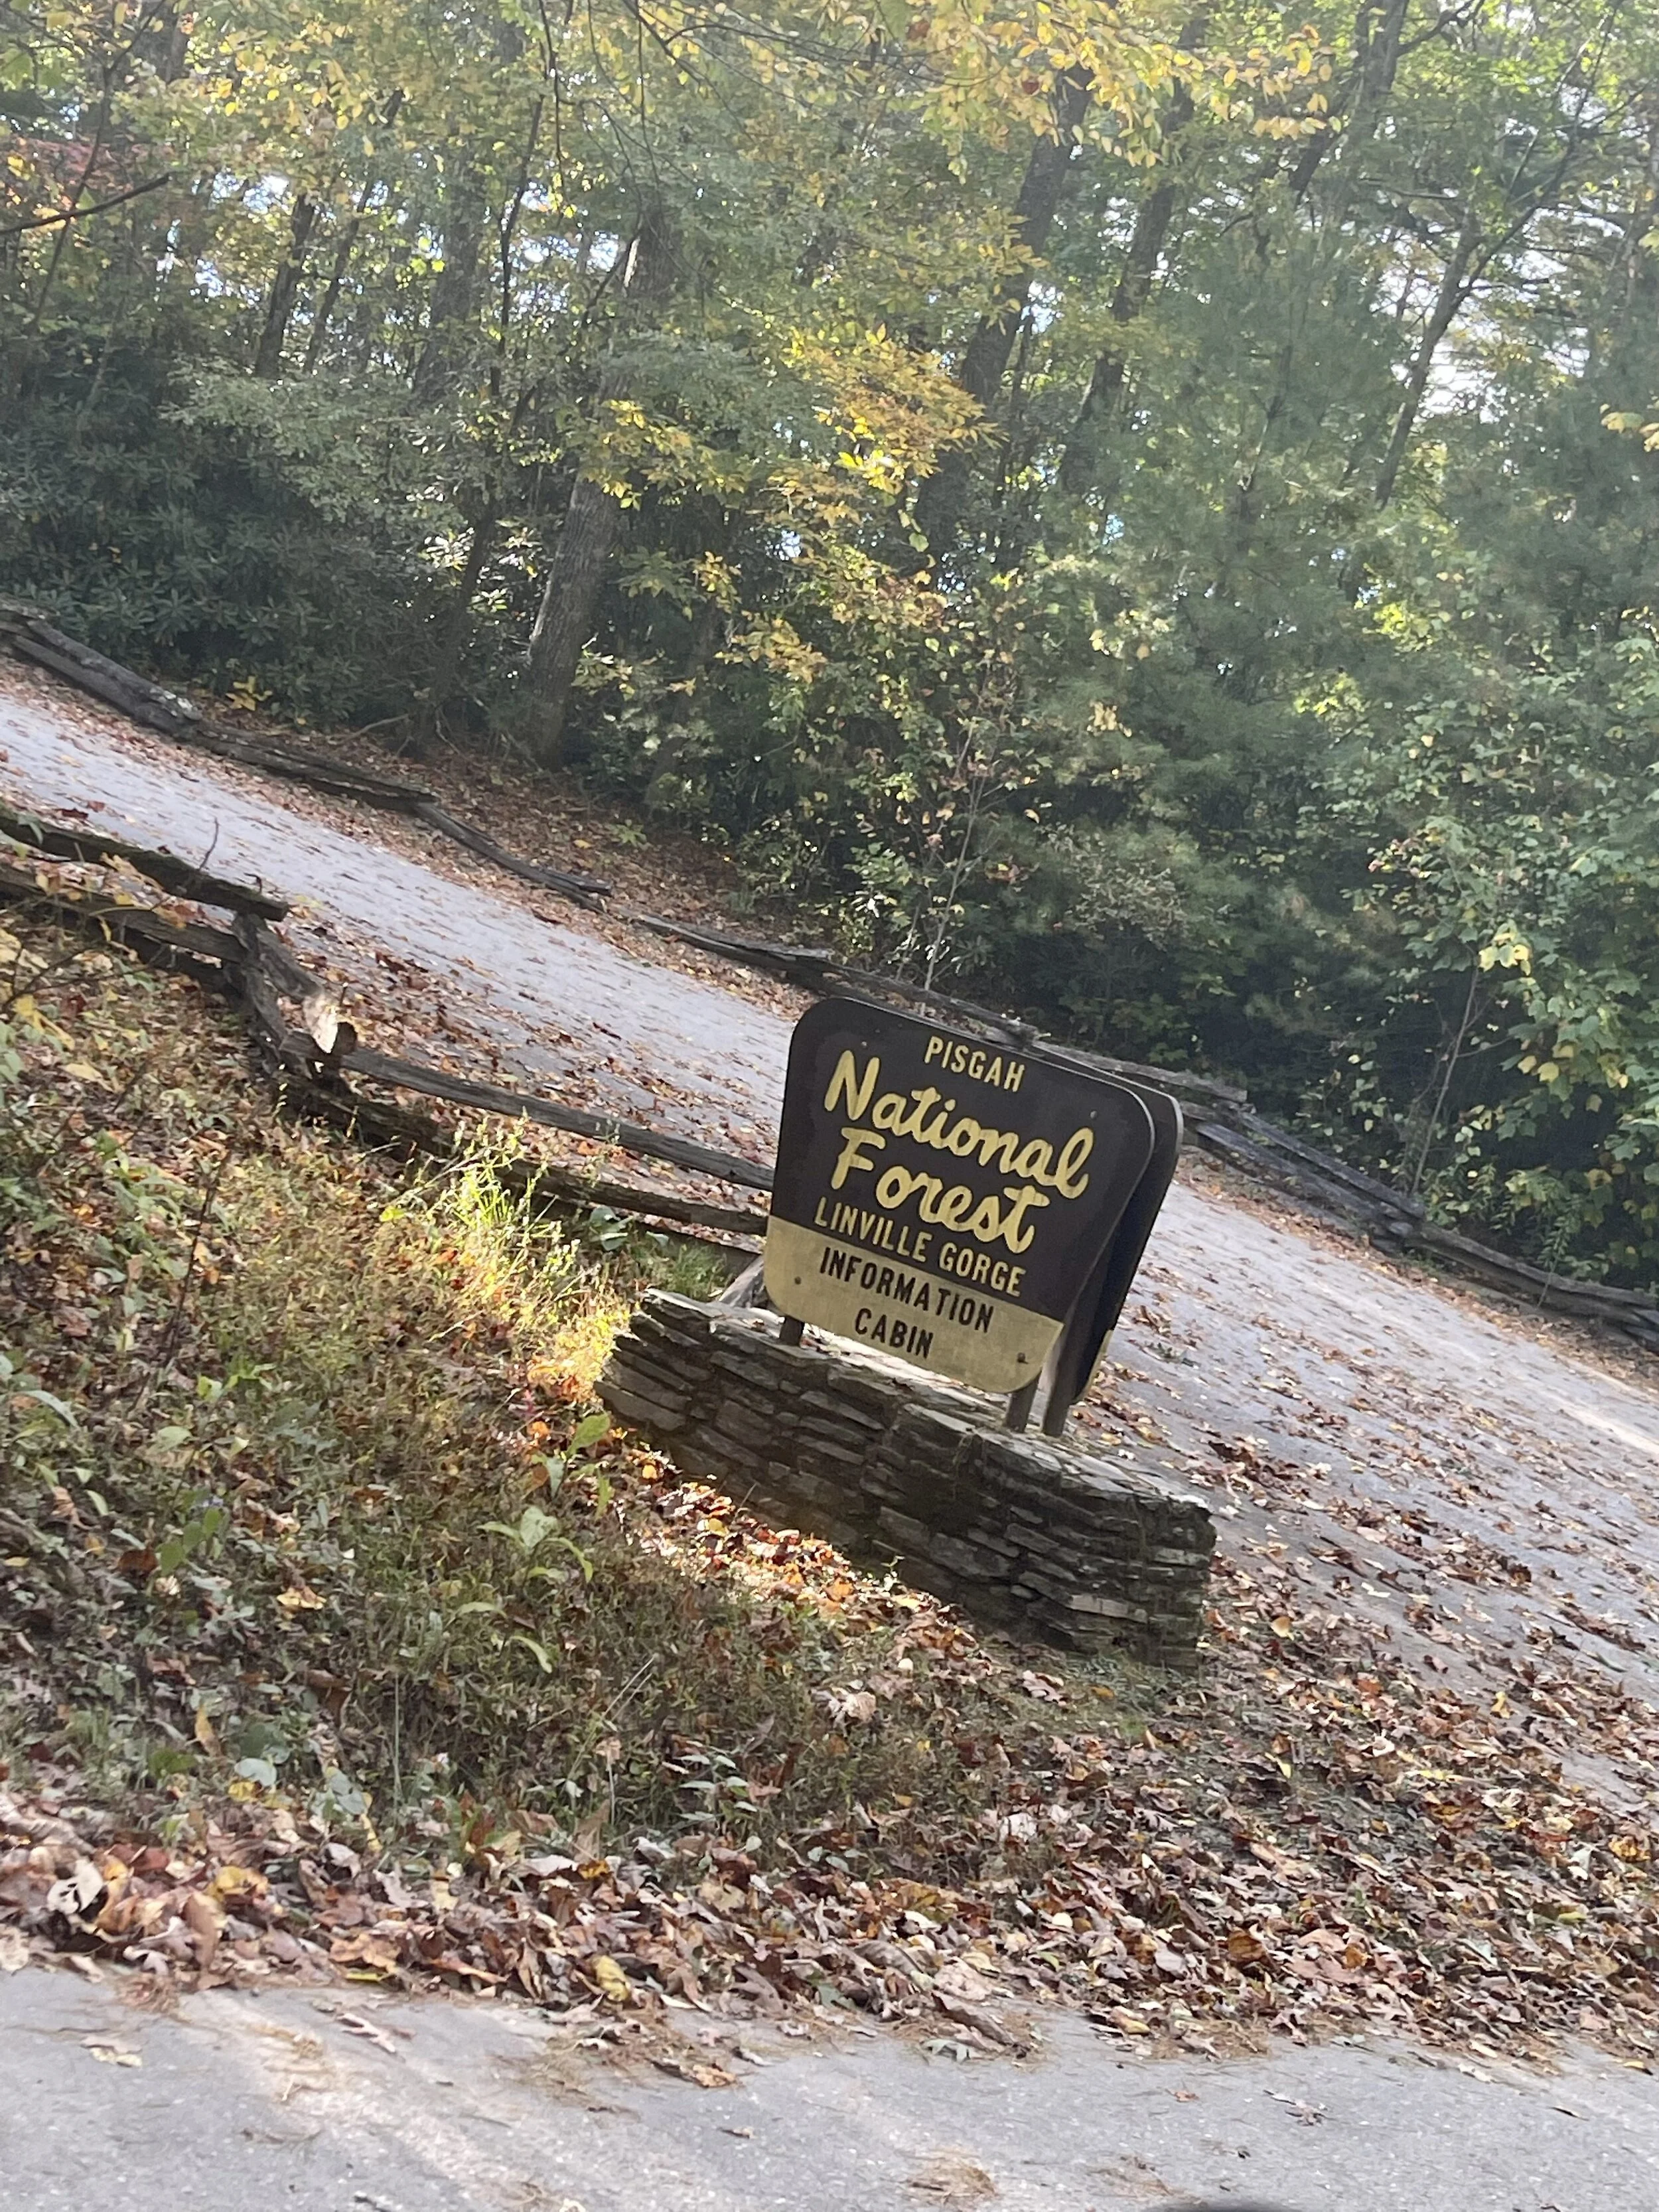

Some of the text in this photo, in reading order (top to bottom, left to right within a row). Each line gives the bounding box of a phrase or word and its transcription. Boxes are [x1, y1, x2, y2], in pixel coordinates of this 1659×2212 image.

[924, 1035, 1025, 1092] PISGAH
[824, 1050, 1095, 1199] National
[831, 1127, 1050, 1254] Forest
[814, 1197, 1027, 1297] LINVILLE GORGE
[820, 1246, 994, 1333] INFORMATION
[855, 1307, 934, 1358] CABIN
